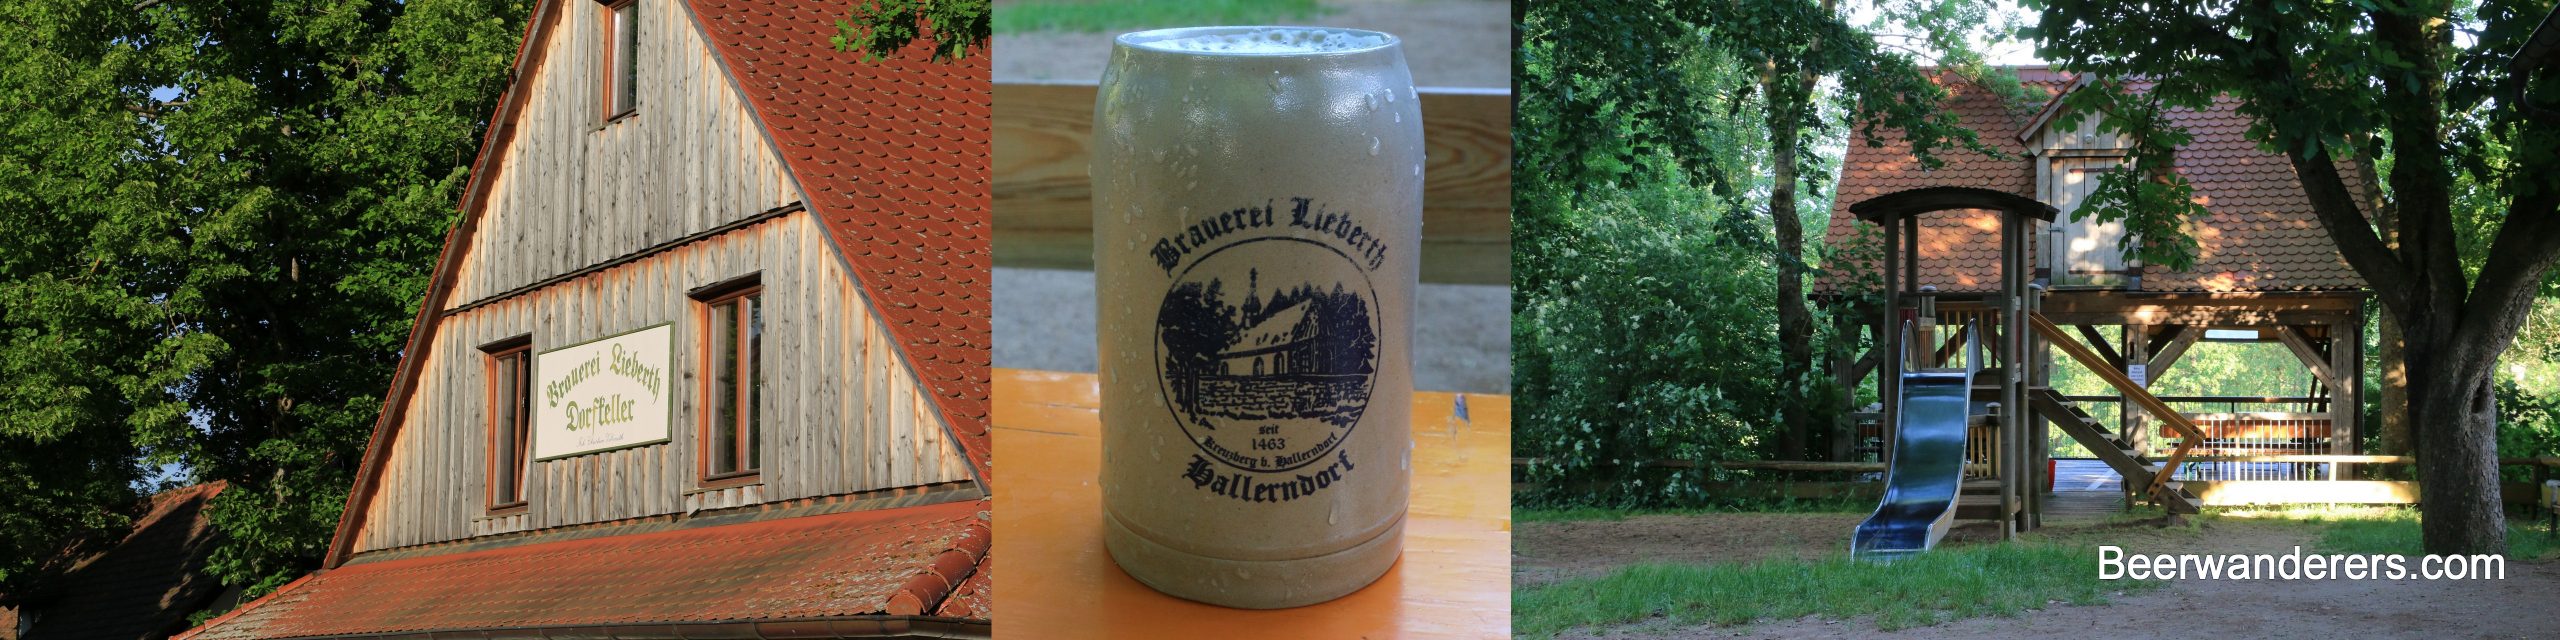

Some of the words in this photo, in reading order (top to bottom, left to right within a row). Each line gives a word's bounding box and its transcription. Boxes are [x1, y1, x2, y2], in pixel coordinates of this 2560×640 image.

[1150, 198, 1274, 278] Brauerei
[1289, 196, 1388, 272] Lieberth
[546, 351, 601, 409] Brauerei
[609, 342, 661, 405] Lieberth
[565, 393, 635, 435] Dorfkeller
[1258, 424, 1279, 435] seit
[1202, 435, 1257, 468] Kreuzberg
[1260, 456, 1271, 468] b.
[1274, 432, 1338, 468] Hallerndorf
[1251, 438, 1286, 450] 1463
[1182, 449, 1355, 503] Hallerndorf
